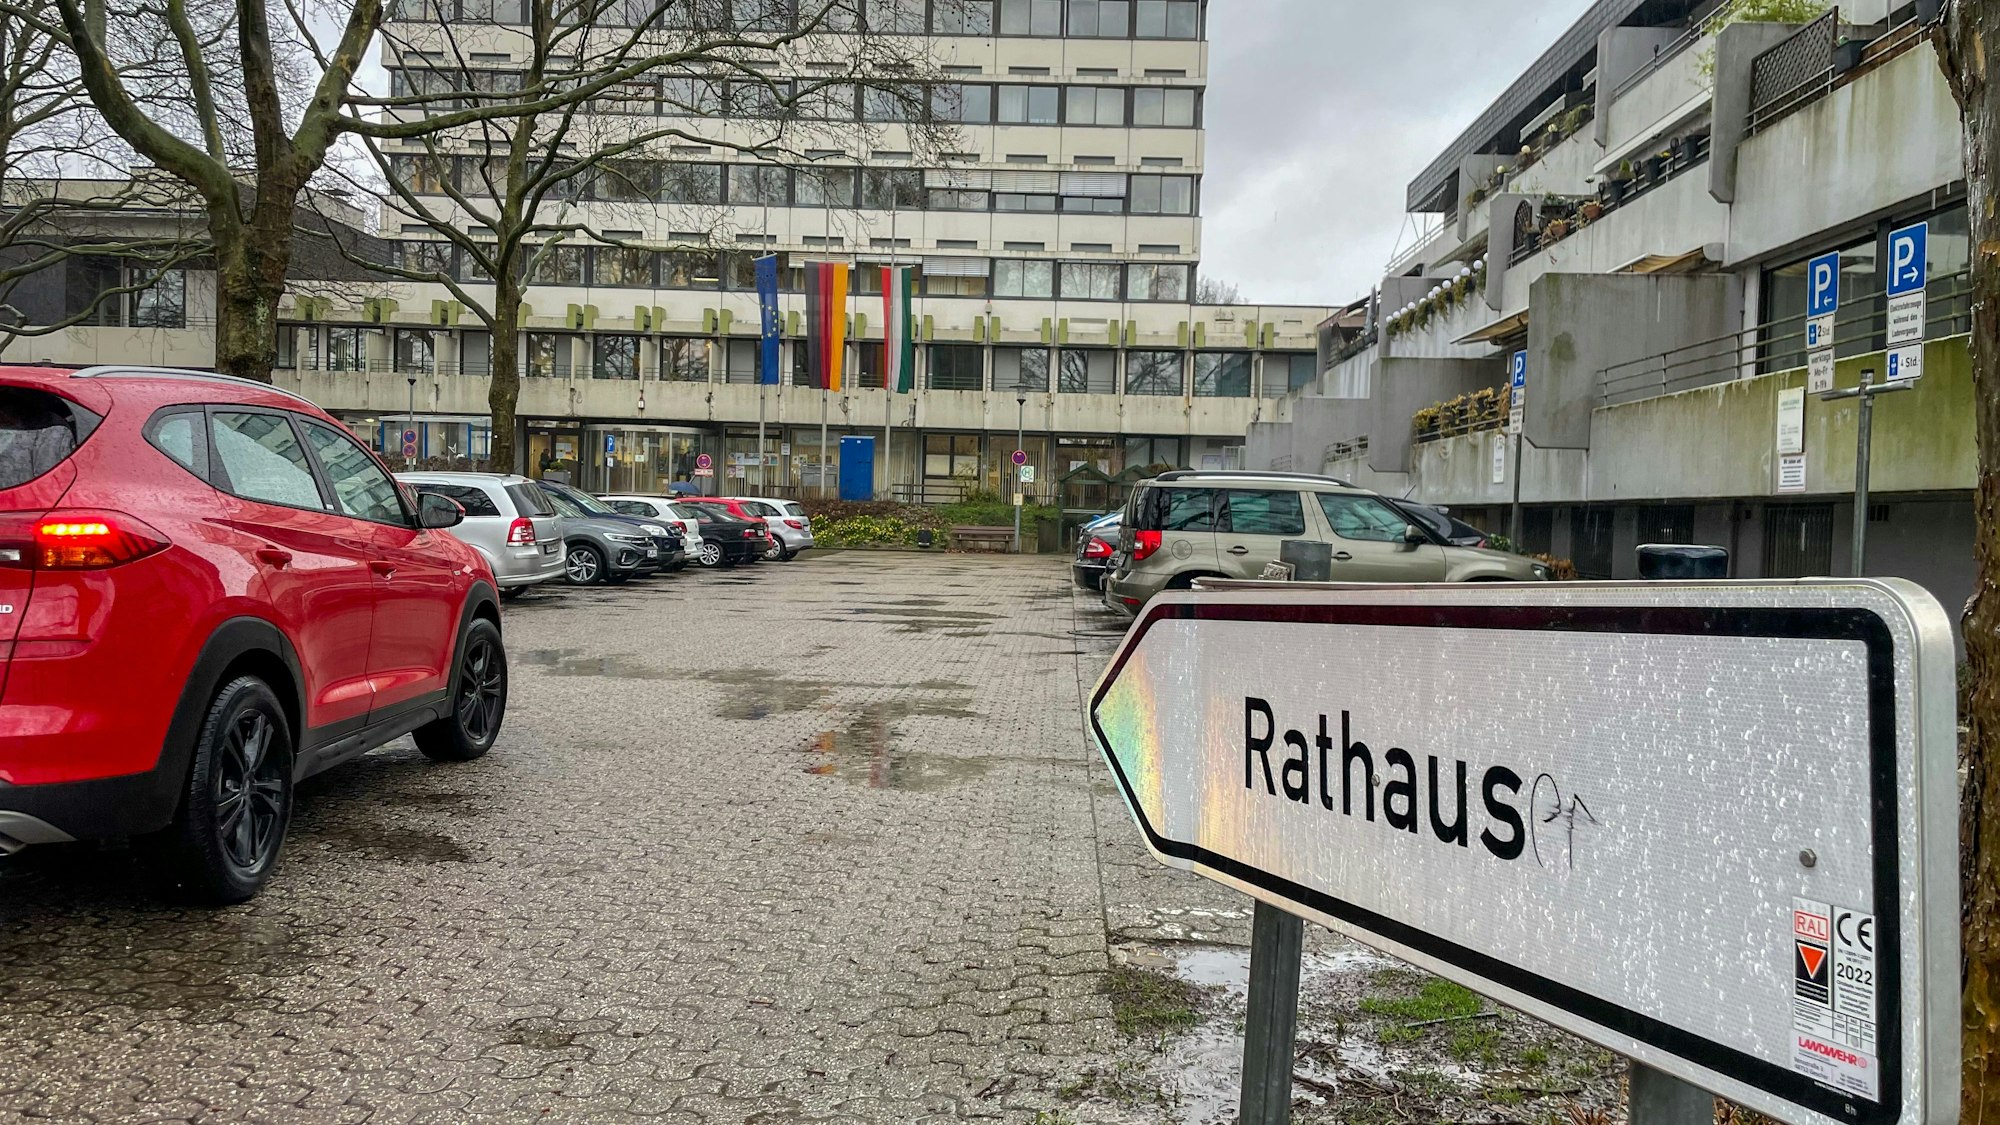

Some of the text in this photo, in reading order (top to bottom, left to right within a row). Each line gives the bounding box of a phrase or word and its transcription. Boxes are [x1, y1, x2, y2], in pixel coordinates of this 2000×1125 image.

[1893, 236, 1915, 287] P
[1814, 263, 1832, 309] P
[1817, 325, 1822, 338] 2
[1514, 356, 1523, 384] P
[608, 437, 613, 449] P
[1245, 696, 1526, 861] Rathaus
[1796, 915, 1825, 937] RAL
[1836, 962, 1873, 986] 2022
[1797, 1035, 1858, 1067] LANDWEHR
